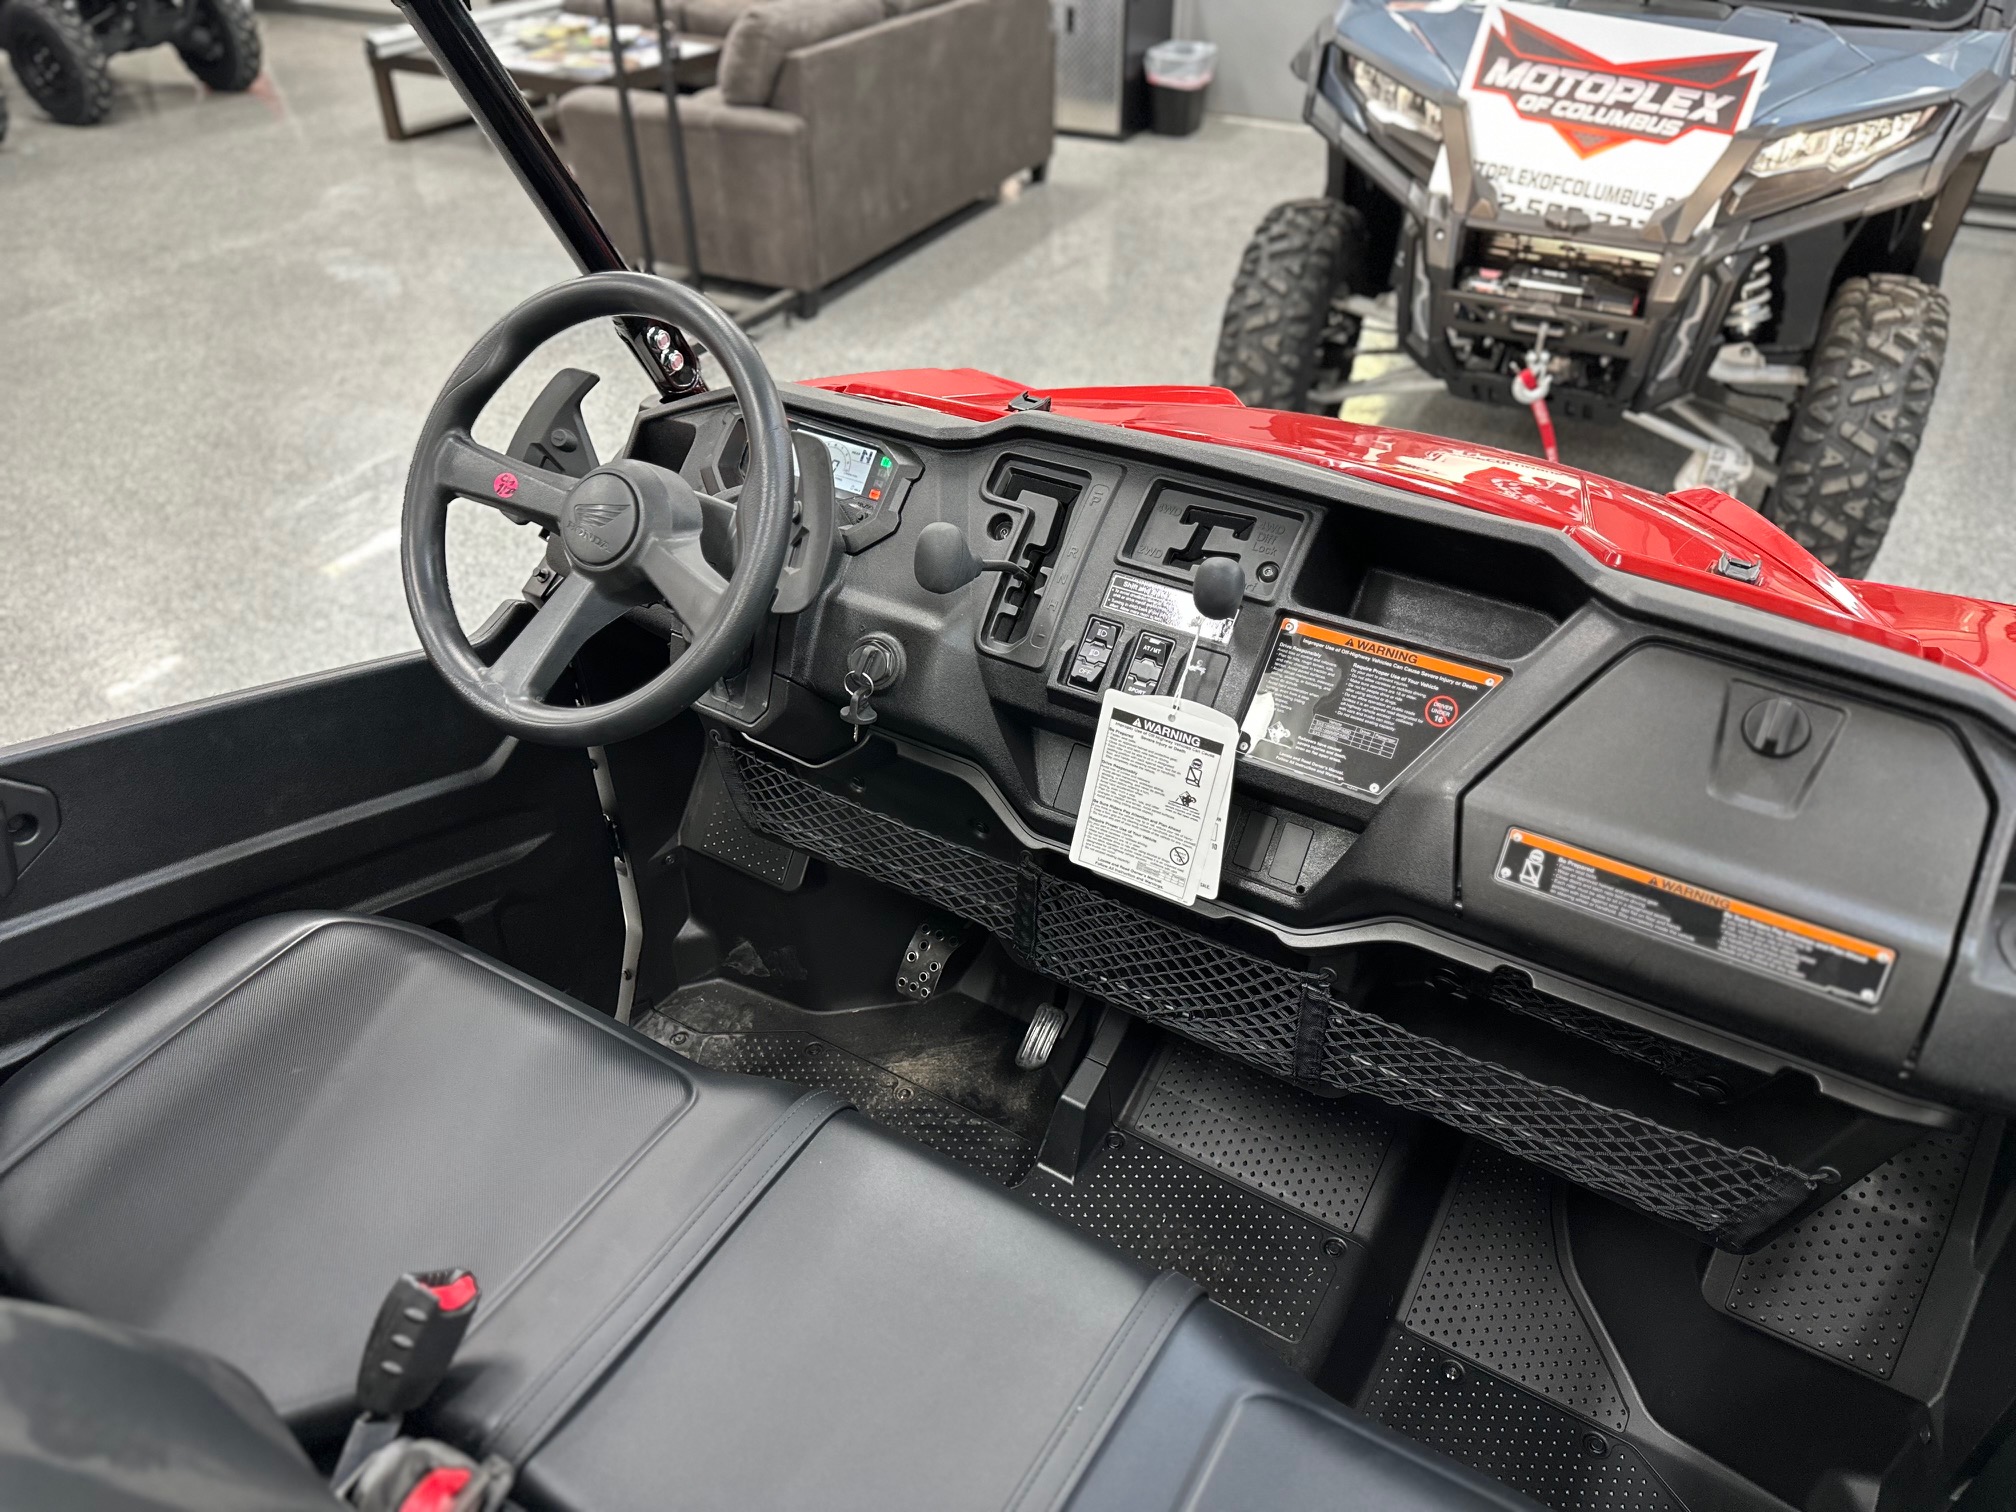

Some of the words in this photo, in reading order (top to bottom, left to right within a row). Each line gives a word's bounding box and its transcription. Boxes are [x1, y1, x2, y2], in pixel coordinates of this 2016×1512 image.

[1483, 56, 1735, 124] MOTOPLEX
[1516, 93, 1555, 113] OF
[1551, 99, 1685, 137] COLUMBUS
[1158, 503, 1183, 517] 4WD
[567, 520, 611, 553] HONDA
[1138, 546, 1163, 559] 2WD
[1252, 543, 1277, 557] Lock
[1143, 645, 1162, 655] AT/MT
[1356, 639, 1418, 664] WARNING
[1301, 638, 1325, 649] Improper
[1371, 657, 1392, 667] Vehicles
[1392, 662, 1403, 670] Can
[1403, 665, 1420, 675] Cause
[1420, 670, 1439, 680] Severe
[1438, 675, 1454, 685] Injury
[1461, 681, 1478, 690] Death
[1352, 662, 1372, 672] Require
[1372, 667, 1389, 677] Proper
[1407, 677, 1419, 685] Your
[1419, 681, 1439, 690] Vehicle
[1128, 686, 1146, 695] SPORT
[1430, 707, 1450, 717] UNDER
[1432, 701, 1453, 712] DRIVER
[1433, 714, 1443, 723] 16
[1142, 719, 1201, 747] WARNING
[1660, 879, 1730, 910] WARNING
